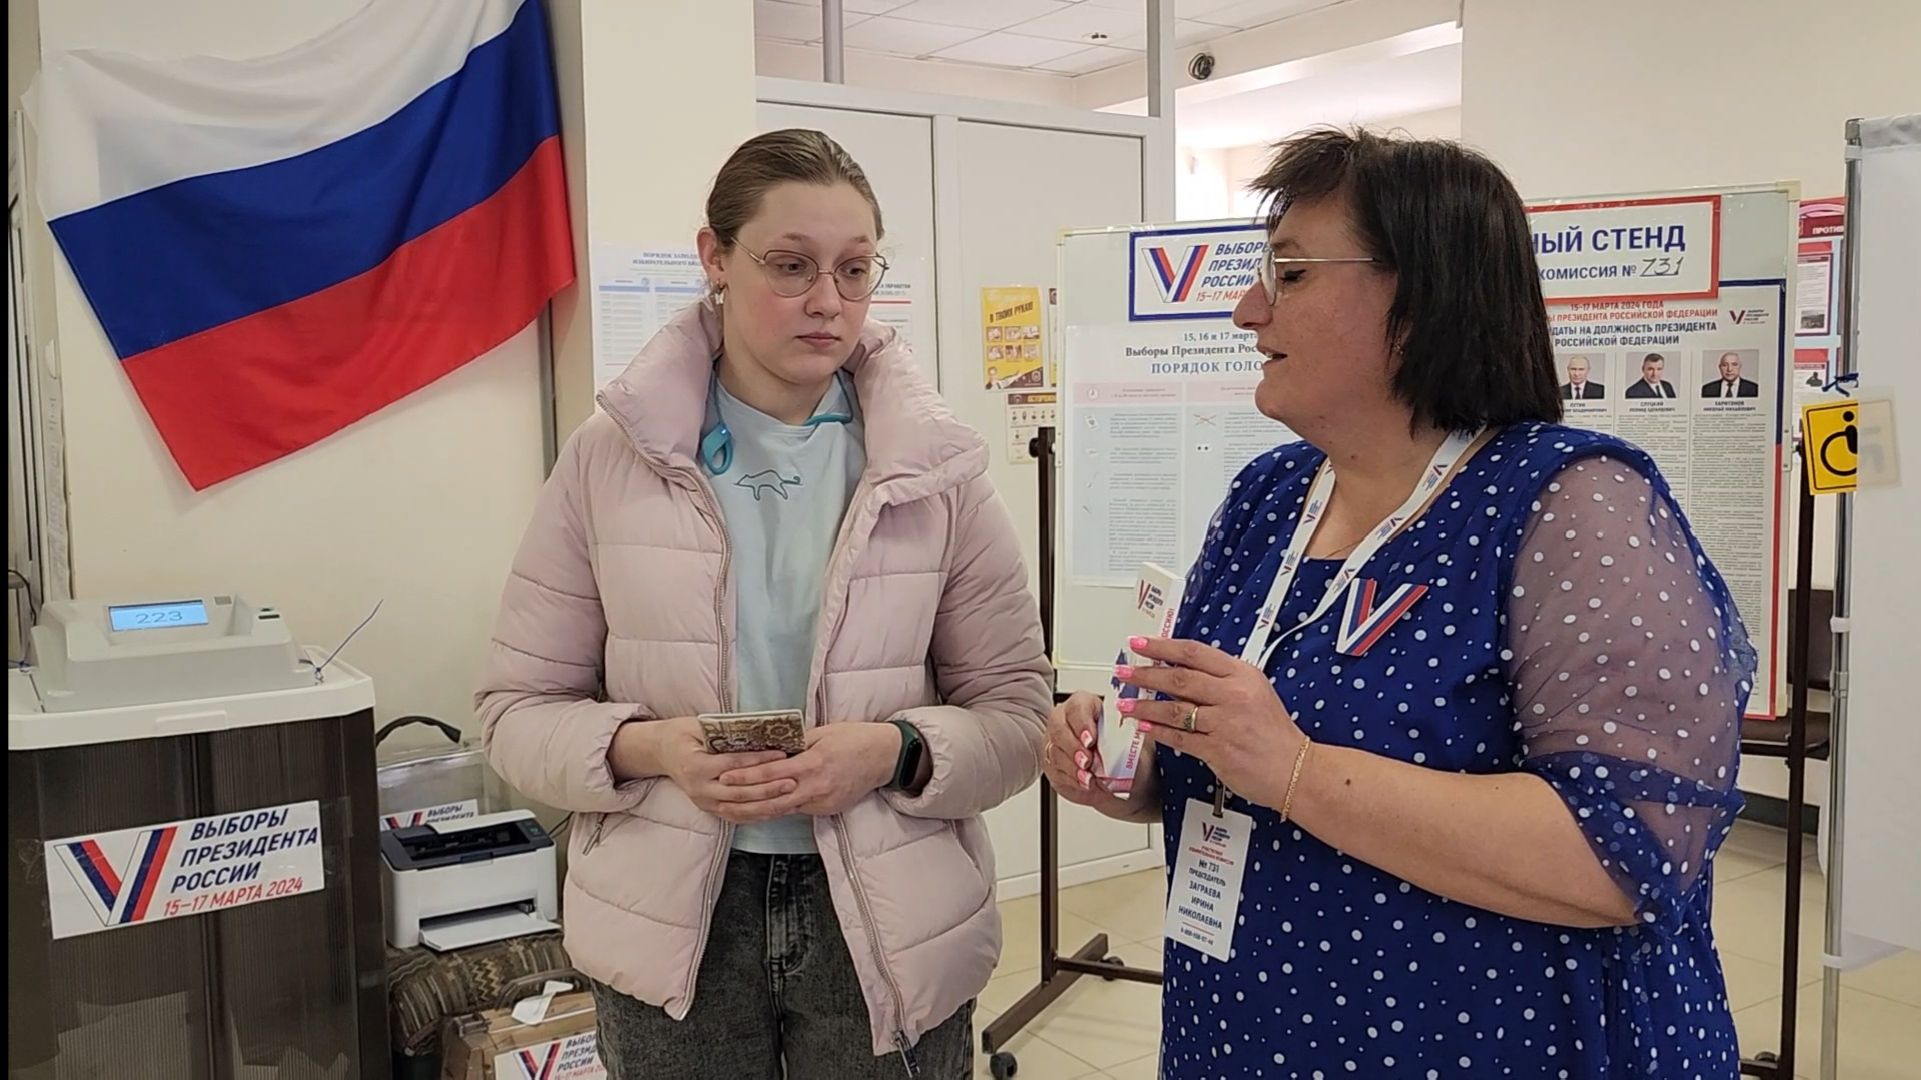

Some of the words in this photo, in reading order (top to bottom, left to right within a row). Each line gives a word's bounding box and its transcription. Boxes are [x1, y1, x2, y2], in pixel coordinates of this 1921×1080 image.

[1591, 225, 1686, 253] СТЕНД
[1201, 274, 1254, 288] РОССИИ
[1592, 301, 1619, 310] МАРТА
[1557, 312, 1608, 322] ПРЕЗИДЕНТА
[1609, 310, 1664, 320] РОССИЙСКОЙ
[1666, 309, 1718, 318] ФЕДЕРАЦИИ
[1579, 326, 1592, 335] НА
[1593, 324, 1653, 335] ДОЛЖНОСТЬ
[1655, 322, 1717, 332] ПРЕЗИДЕНТА
[1199, 332, 1209, 341] 16
[1220, 332, 1230, 340] 17
[1554, 335, 1617, 347] РОССИЙСКОЙ
[1620, 335, 1679, 345] ФЕДЕРАЦИИ
[1125, 346, 1169, 358] Выборы
[1171, 345, 1235, 358] Президента
[1151, 361, 1220, 375] ПОРЯДОК
[136, 611, 183, 624] 223
[190, 808, 289, 842] ВЫБОРЫ
[180, 827, 318, 867] ПРЕЗИДЕНТА
[171, 861, 261, 893] РОССИИ
[209, 884, 263, 909] МАРТА
[266, 876, 303, 898] 2024
[1191, 896, 1214, 912] ИРИНА
[1178, 906, 1222, 930] НИКОЛАЕВНА
